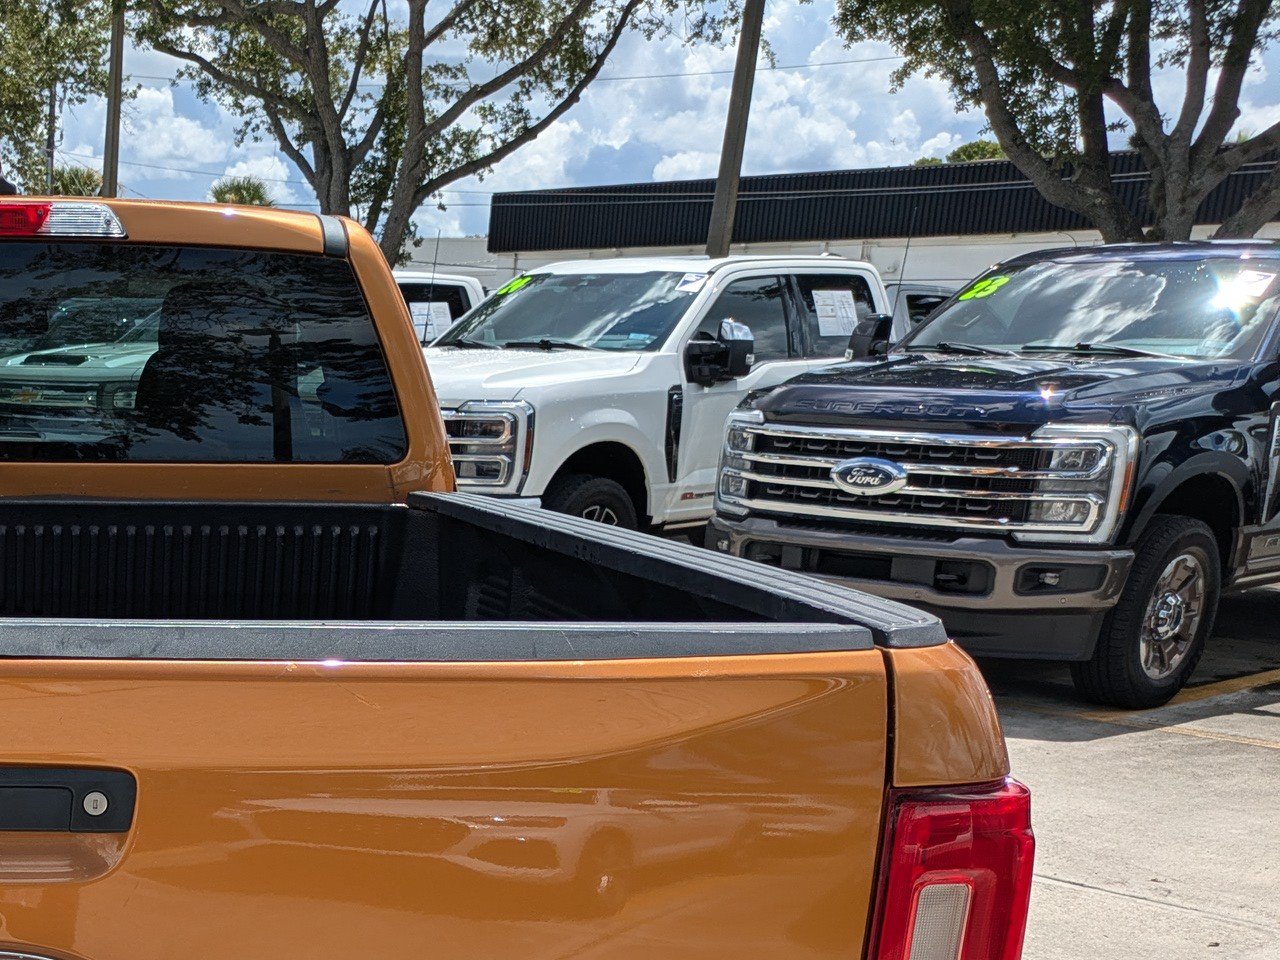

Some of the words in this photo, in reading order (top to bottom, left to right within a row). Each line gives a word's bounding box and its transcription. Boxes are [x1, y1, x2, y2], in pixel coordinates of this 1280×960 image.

[958, 276, 1010, 300] 23
[794, 399, 895, 415] SUPER
[901, 403, 998, 418] DUTY
[846, 467, 884, 486] Ford
